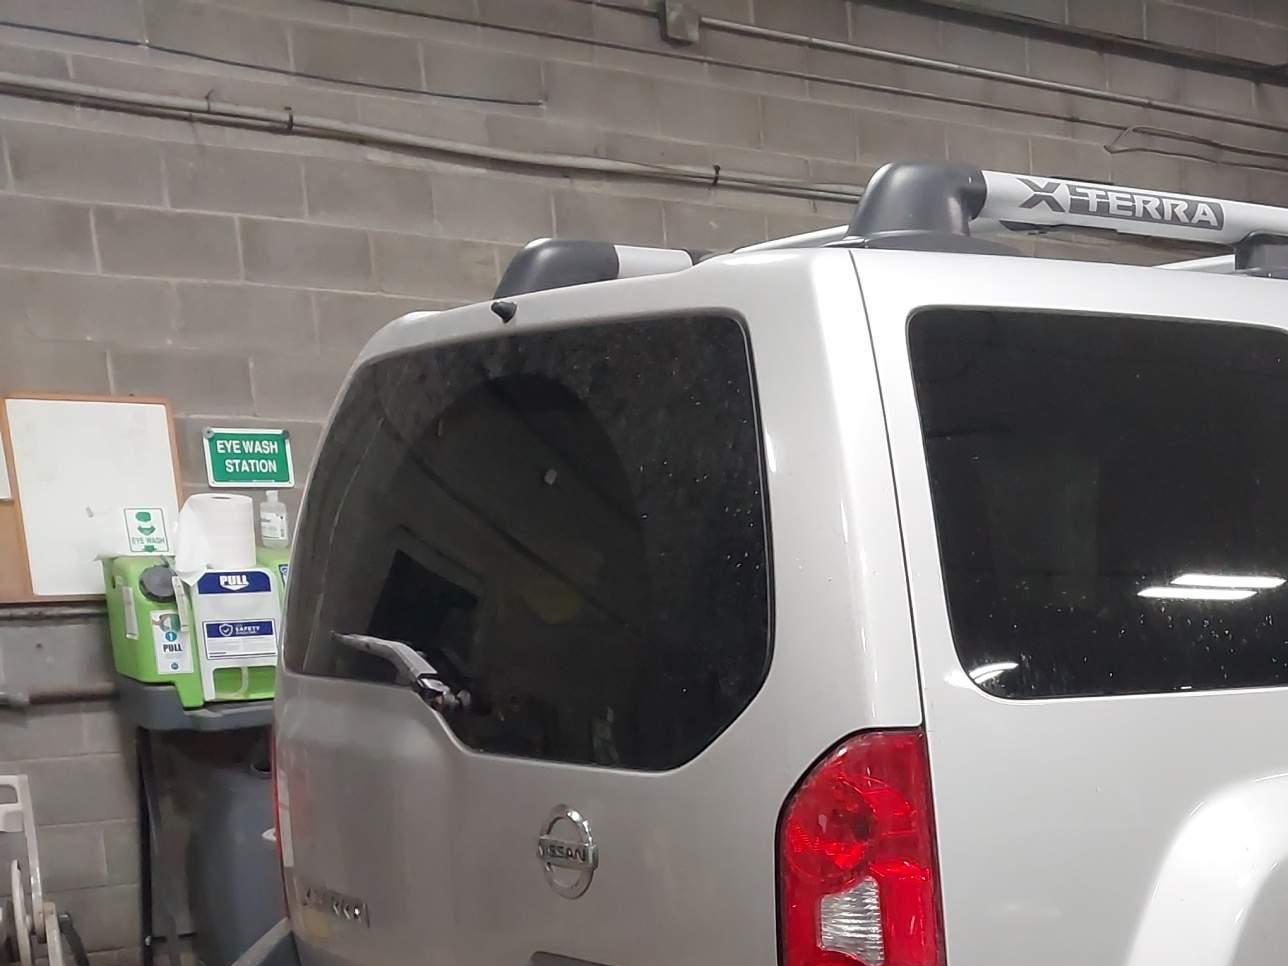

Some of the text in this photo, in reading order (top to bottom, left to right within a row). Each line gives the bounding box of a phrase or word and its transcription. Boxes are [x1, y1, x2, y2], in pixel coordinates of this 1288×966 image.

[216, 440, 278, 454] EYE WASH
[225, 459, 277, 472] STATION
[219, 574, 249, 586] PULL
[163, 644, 183, 652] PULL
